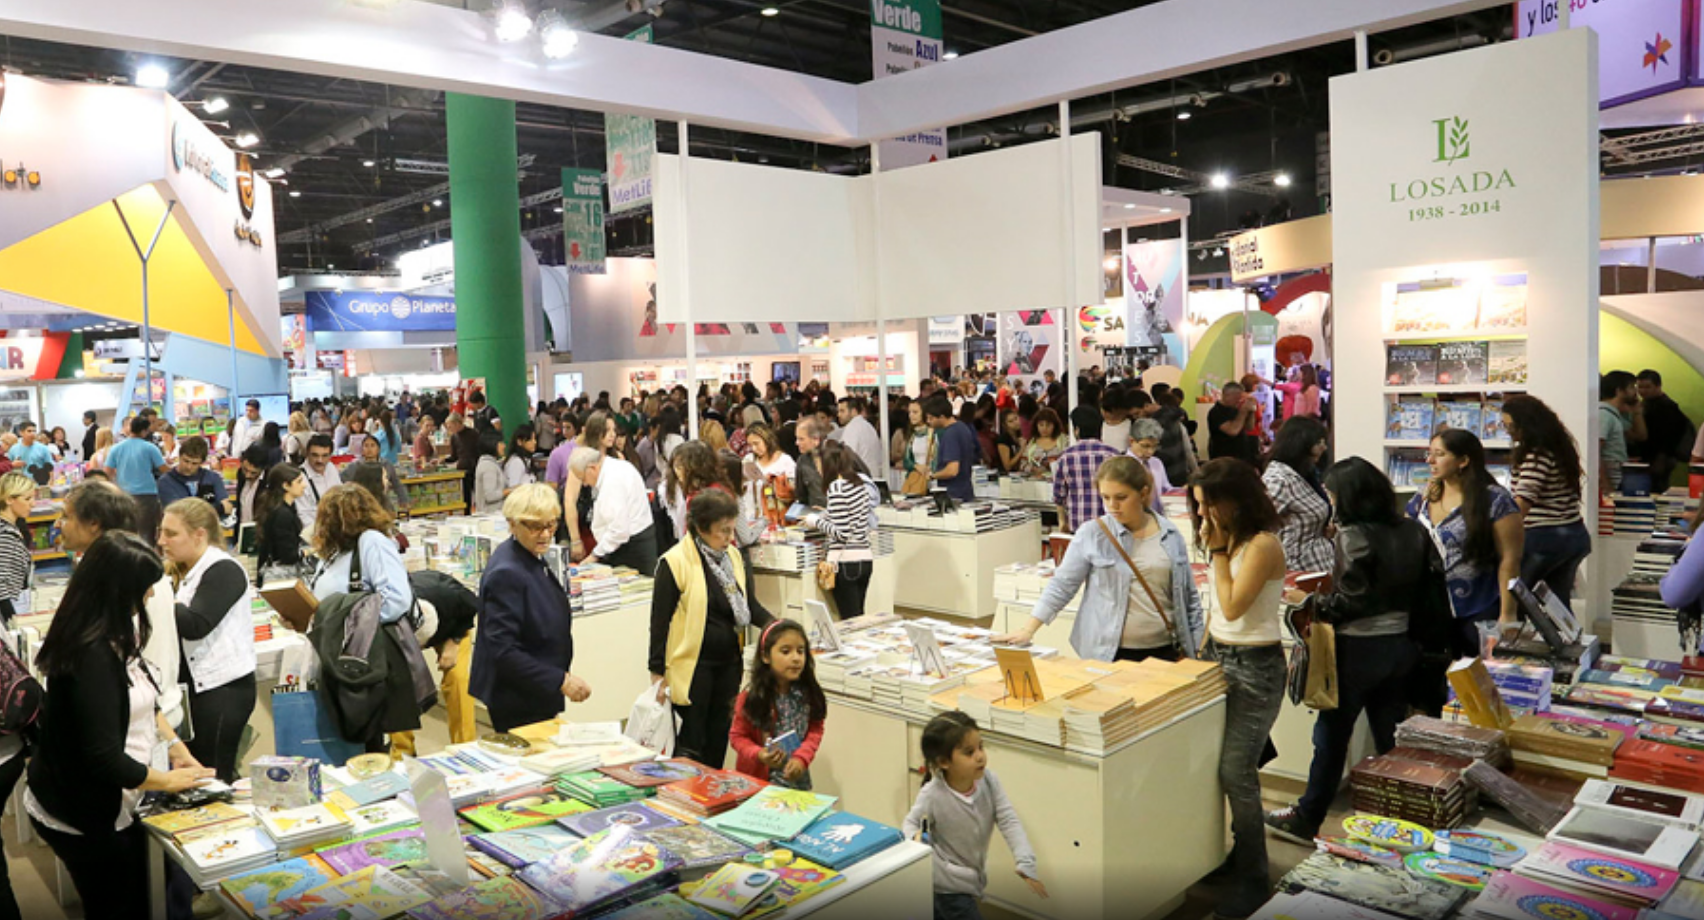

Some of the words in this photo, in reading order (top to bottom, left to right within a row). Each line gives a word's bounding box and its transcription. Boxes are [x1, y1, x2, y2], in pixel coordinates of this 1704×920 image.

[872, 0, 922, 32] Verde
[1527, 9, 1537, 37] y
[916, 39, 938, 62] Azul
[1389, 168, 1517, 203] LOSADA
[1408, 206, 1445, 222] 1938
[1459, 199, 1501, 217] 2014
[349, 300, 389, 319] Grupo
[412, 300, 457, 315] Planeta
